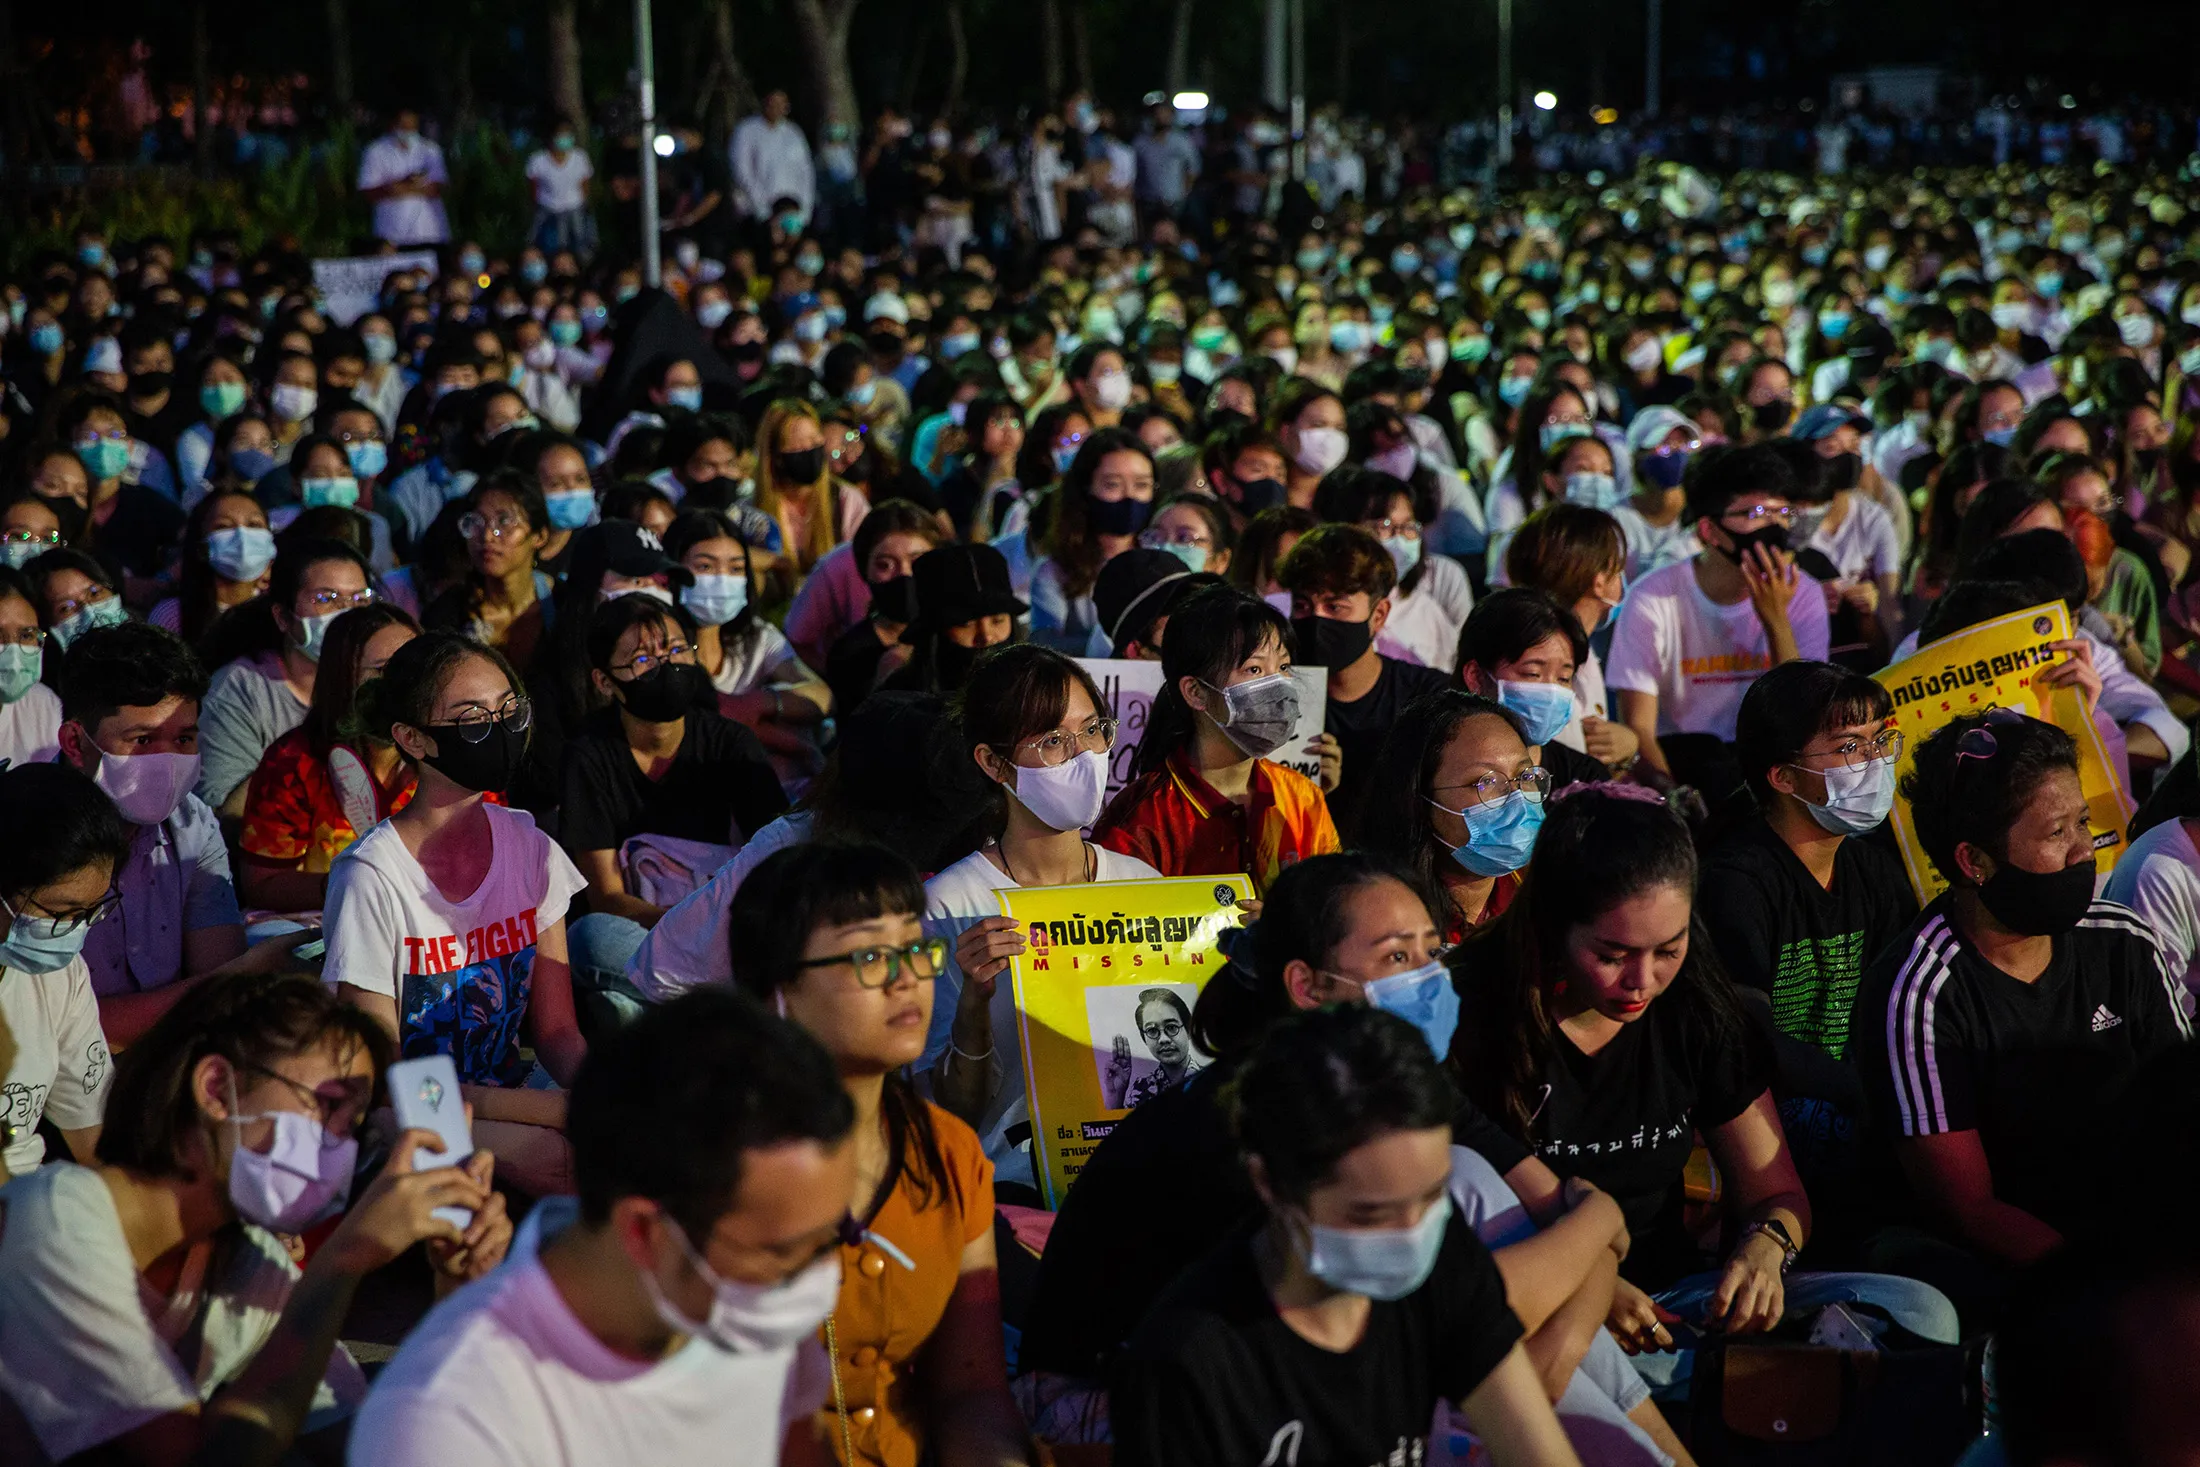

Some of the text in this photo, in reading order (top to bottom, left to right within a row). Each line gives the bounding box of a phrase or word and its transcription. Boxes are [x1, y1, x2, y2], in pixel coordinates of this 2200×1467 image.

[1885, 677, 2030, 728] MISSIN
[1888, 642, 2054, 717] ูกบังคับสูญหาย
[404, 906, 538, 976] THE FIGHT
[1029, 911, 1205, 956] ถูกบังคับสูญห
[1033, 952, 1231, 971] MISSIN
[2091, 1016, 2123, 1032] adidas
